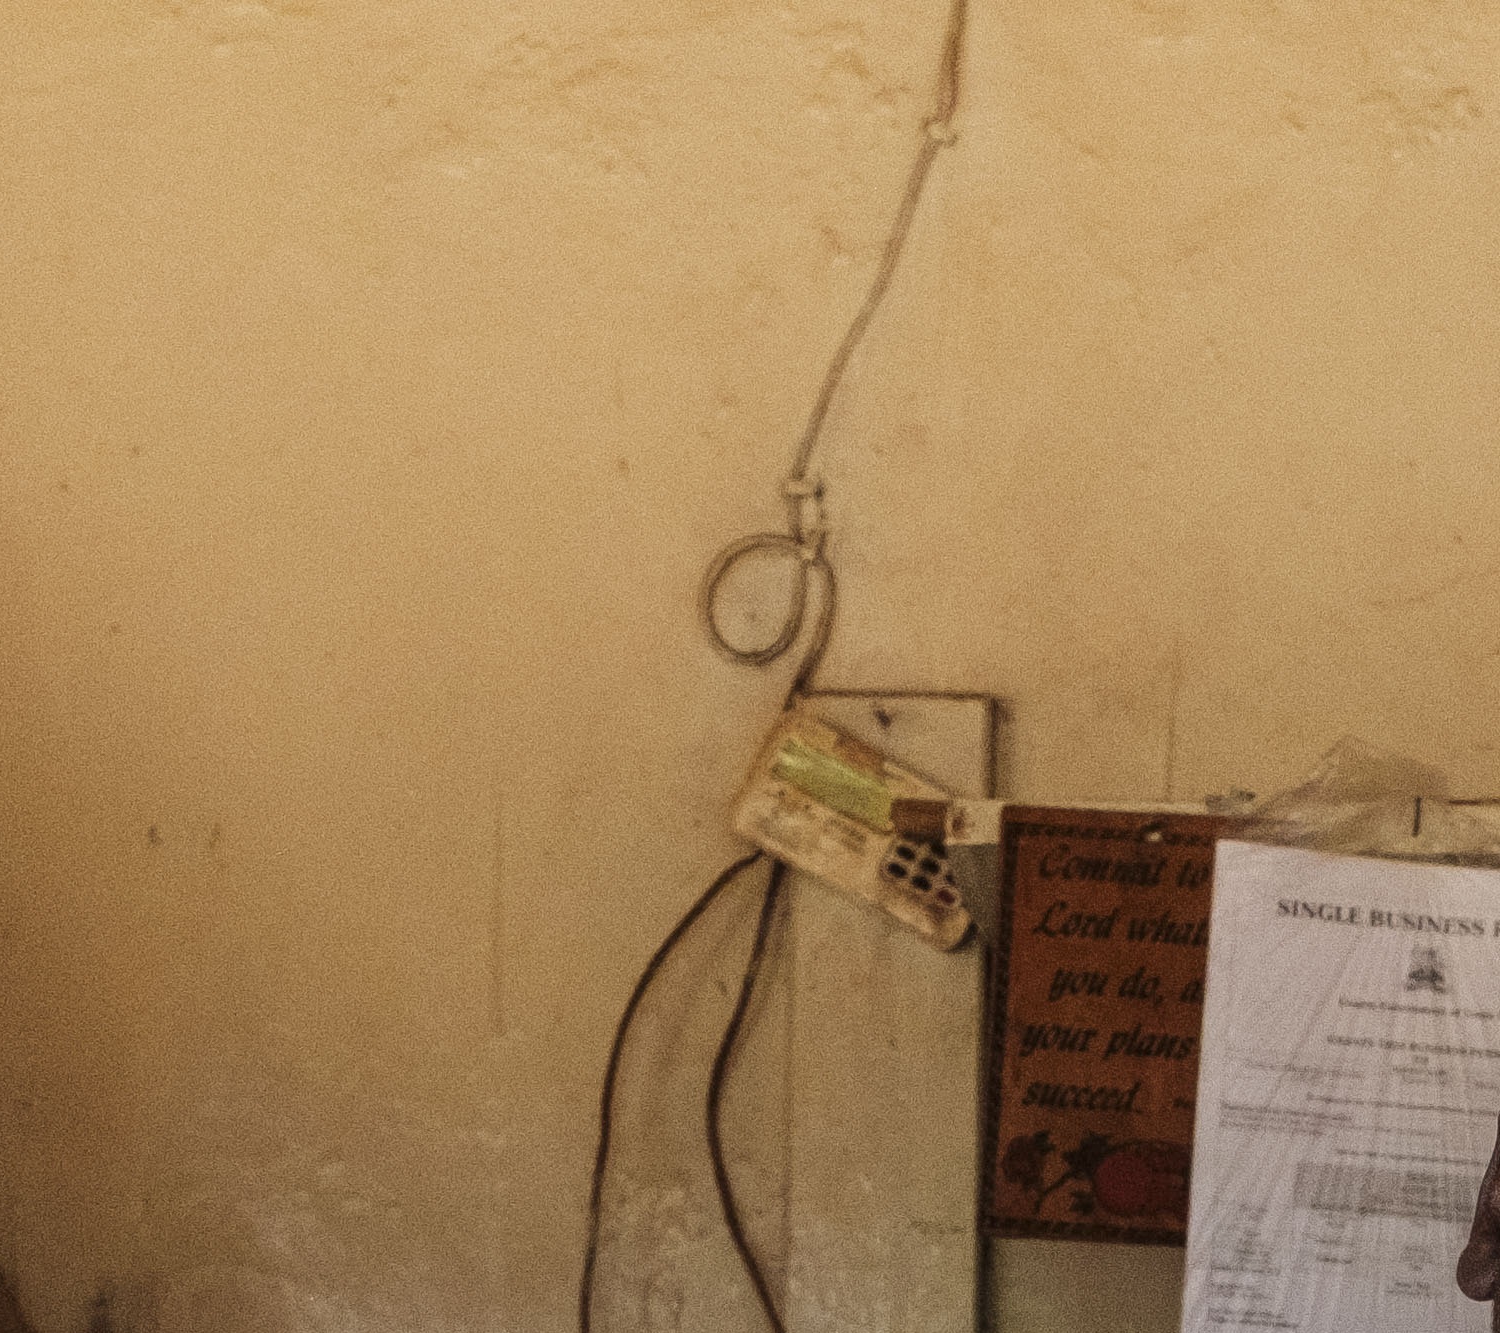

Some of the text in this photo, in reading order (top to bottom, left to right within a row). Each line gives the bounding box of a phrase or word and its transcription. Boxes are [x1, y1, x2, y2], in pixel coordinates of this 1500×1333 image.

[1033, 901, 1121, 940] Lord
[1278, 899, 1361, 926] SINGLE
[1368, 911, 1486, 938] BUSINESS
[1049, 968, 1108, 1000] you
[1018, 1023, 1197, 1060] your plans
